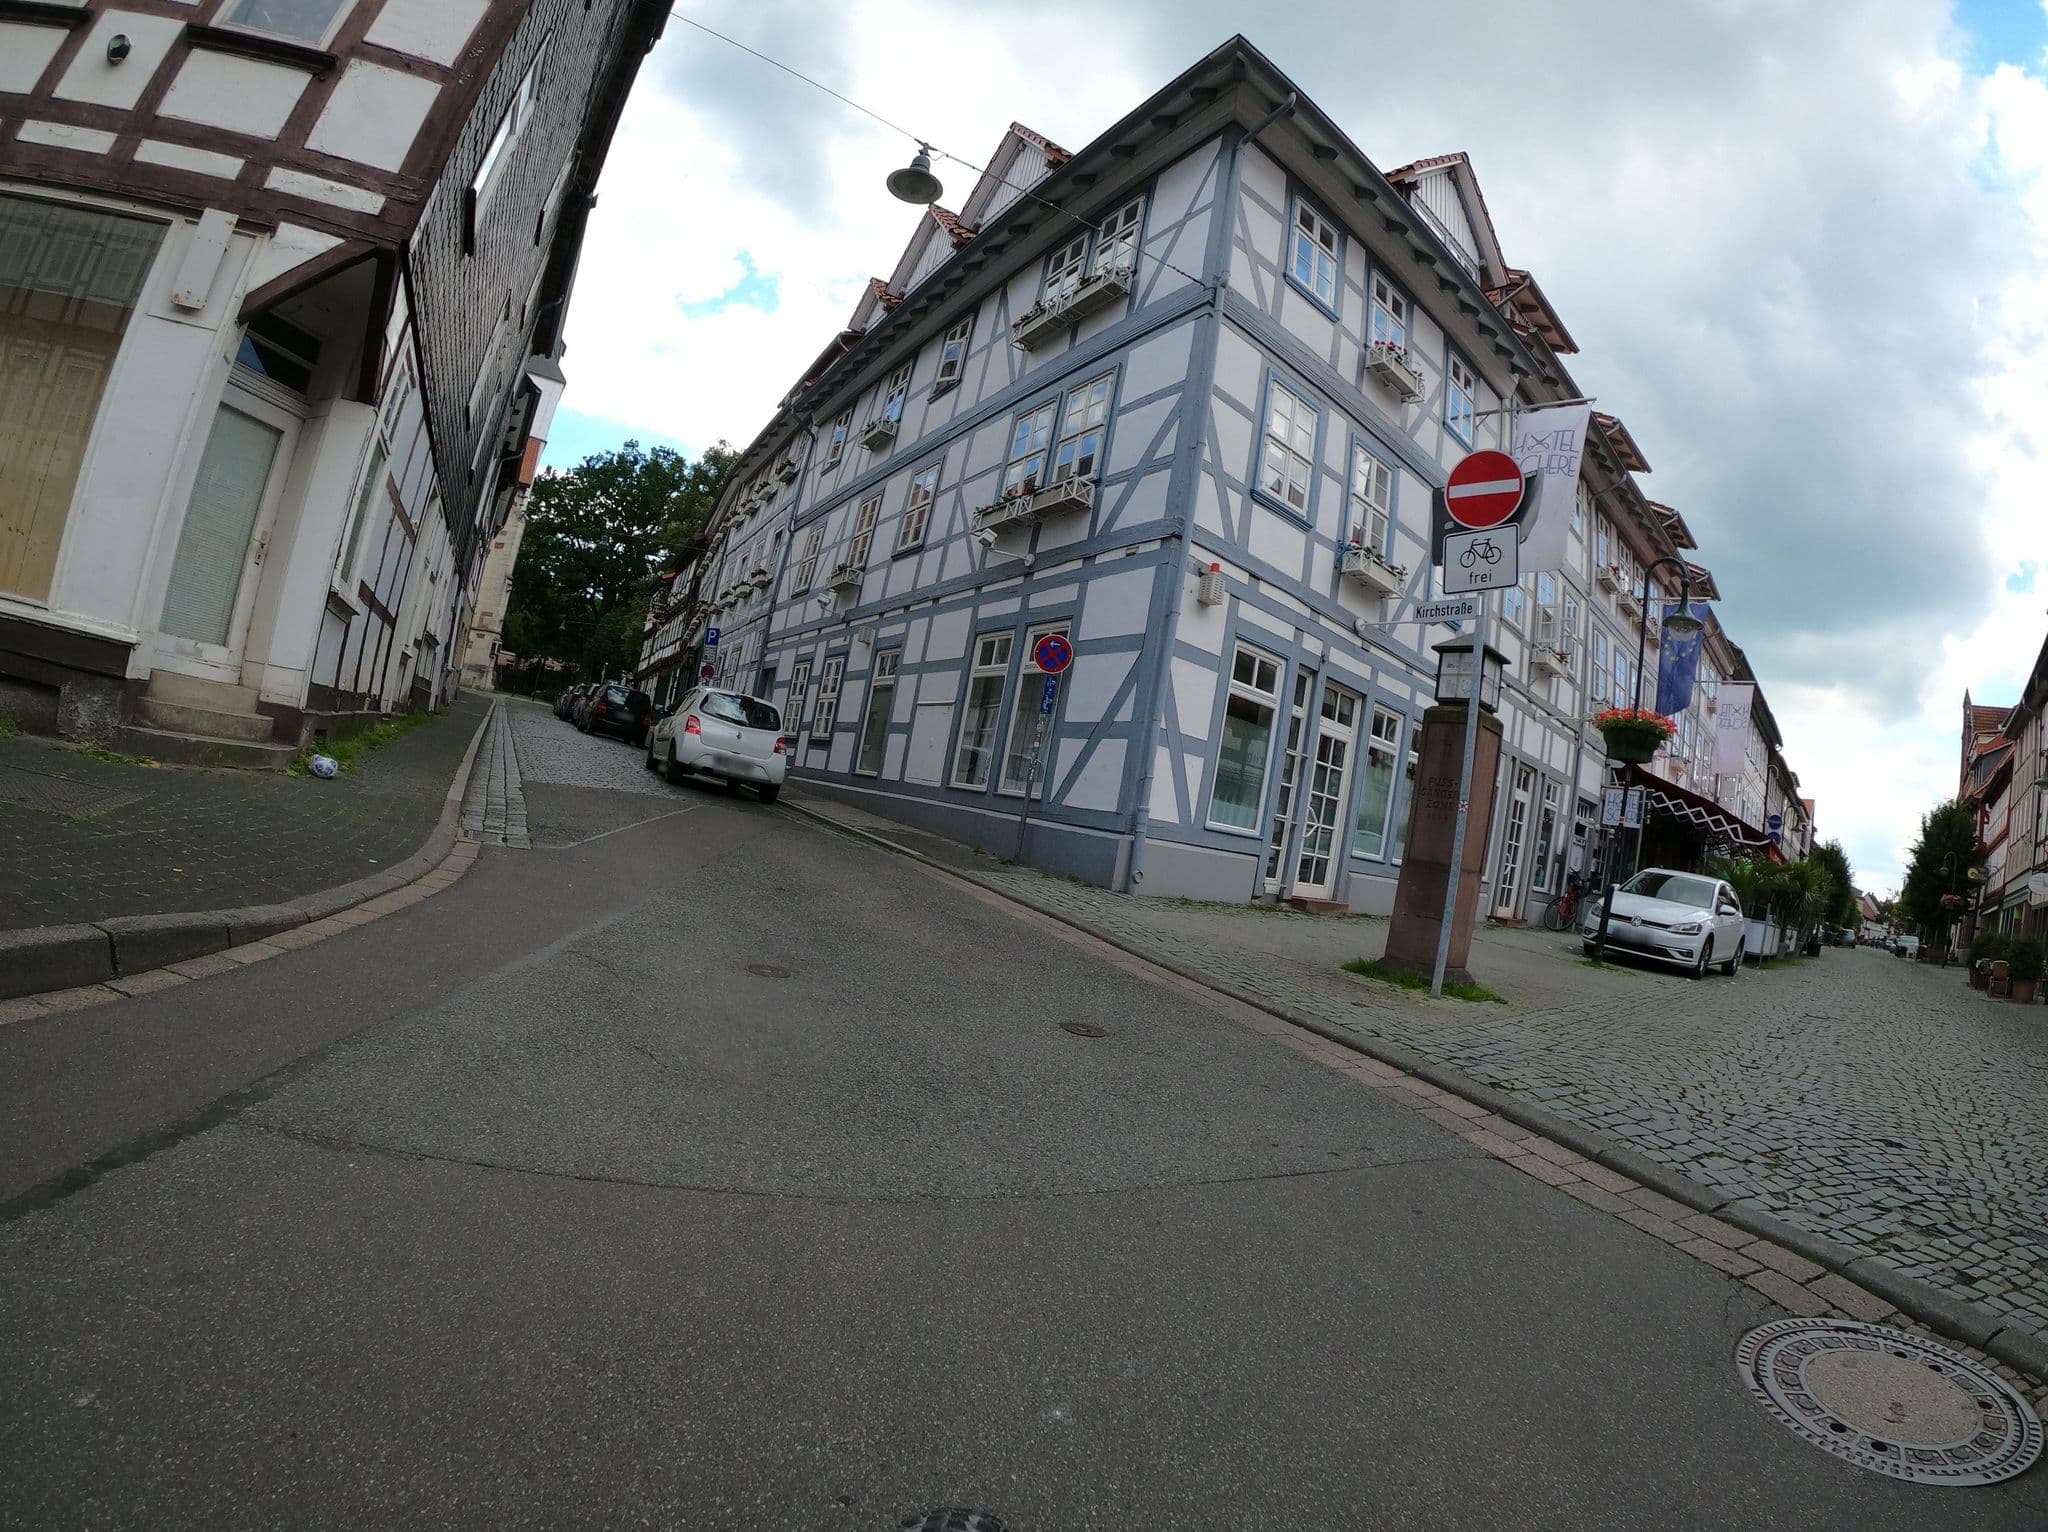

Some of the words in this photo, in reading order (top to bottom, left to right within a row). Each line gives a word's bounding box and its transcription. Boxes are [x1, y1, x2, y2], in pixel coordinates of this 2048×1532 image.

[1514, 453, 1577, 477] CHERE
[1469, 569, 1492, 584] frei
[1416, 602, 1473, 619] Kirchstraße
[708, 629, 717, 643] P
